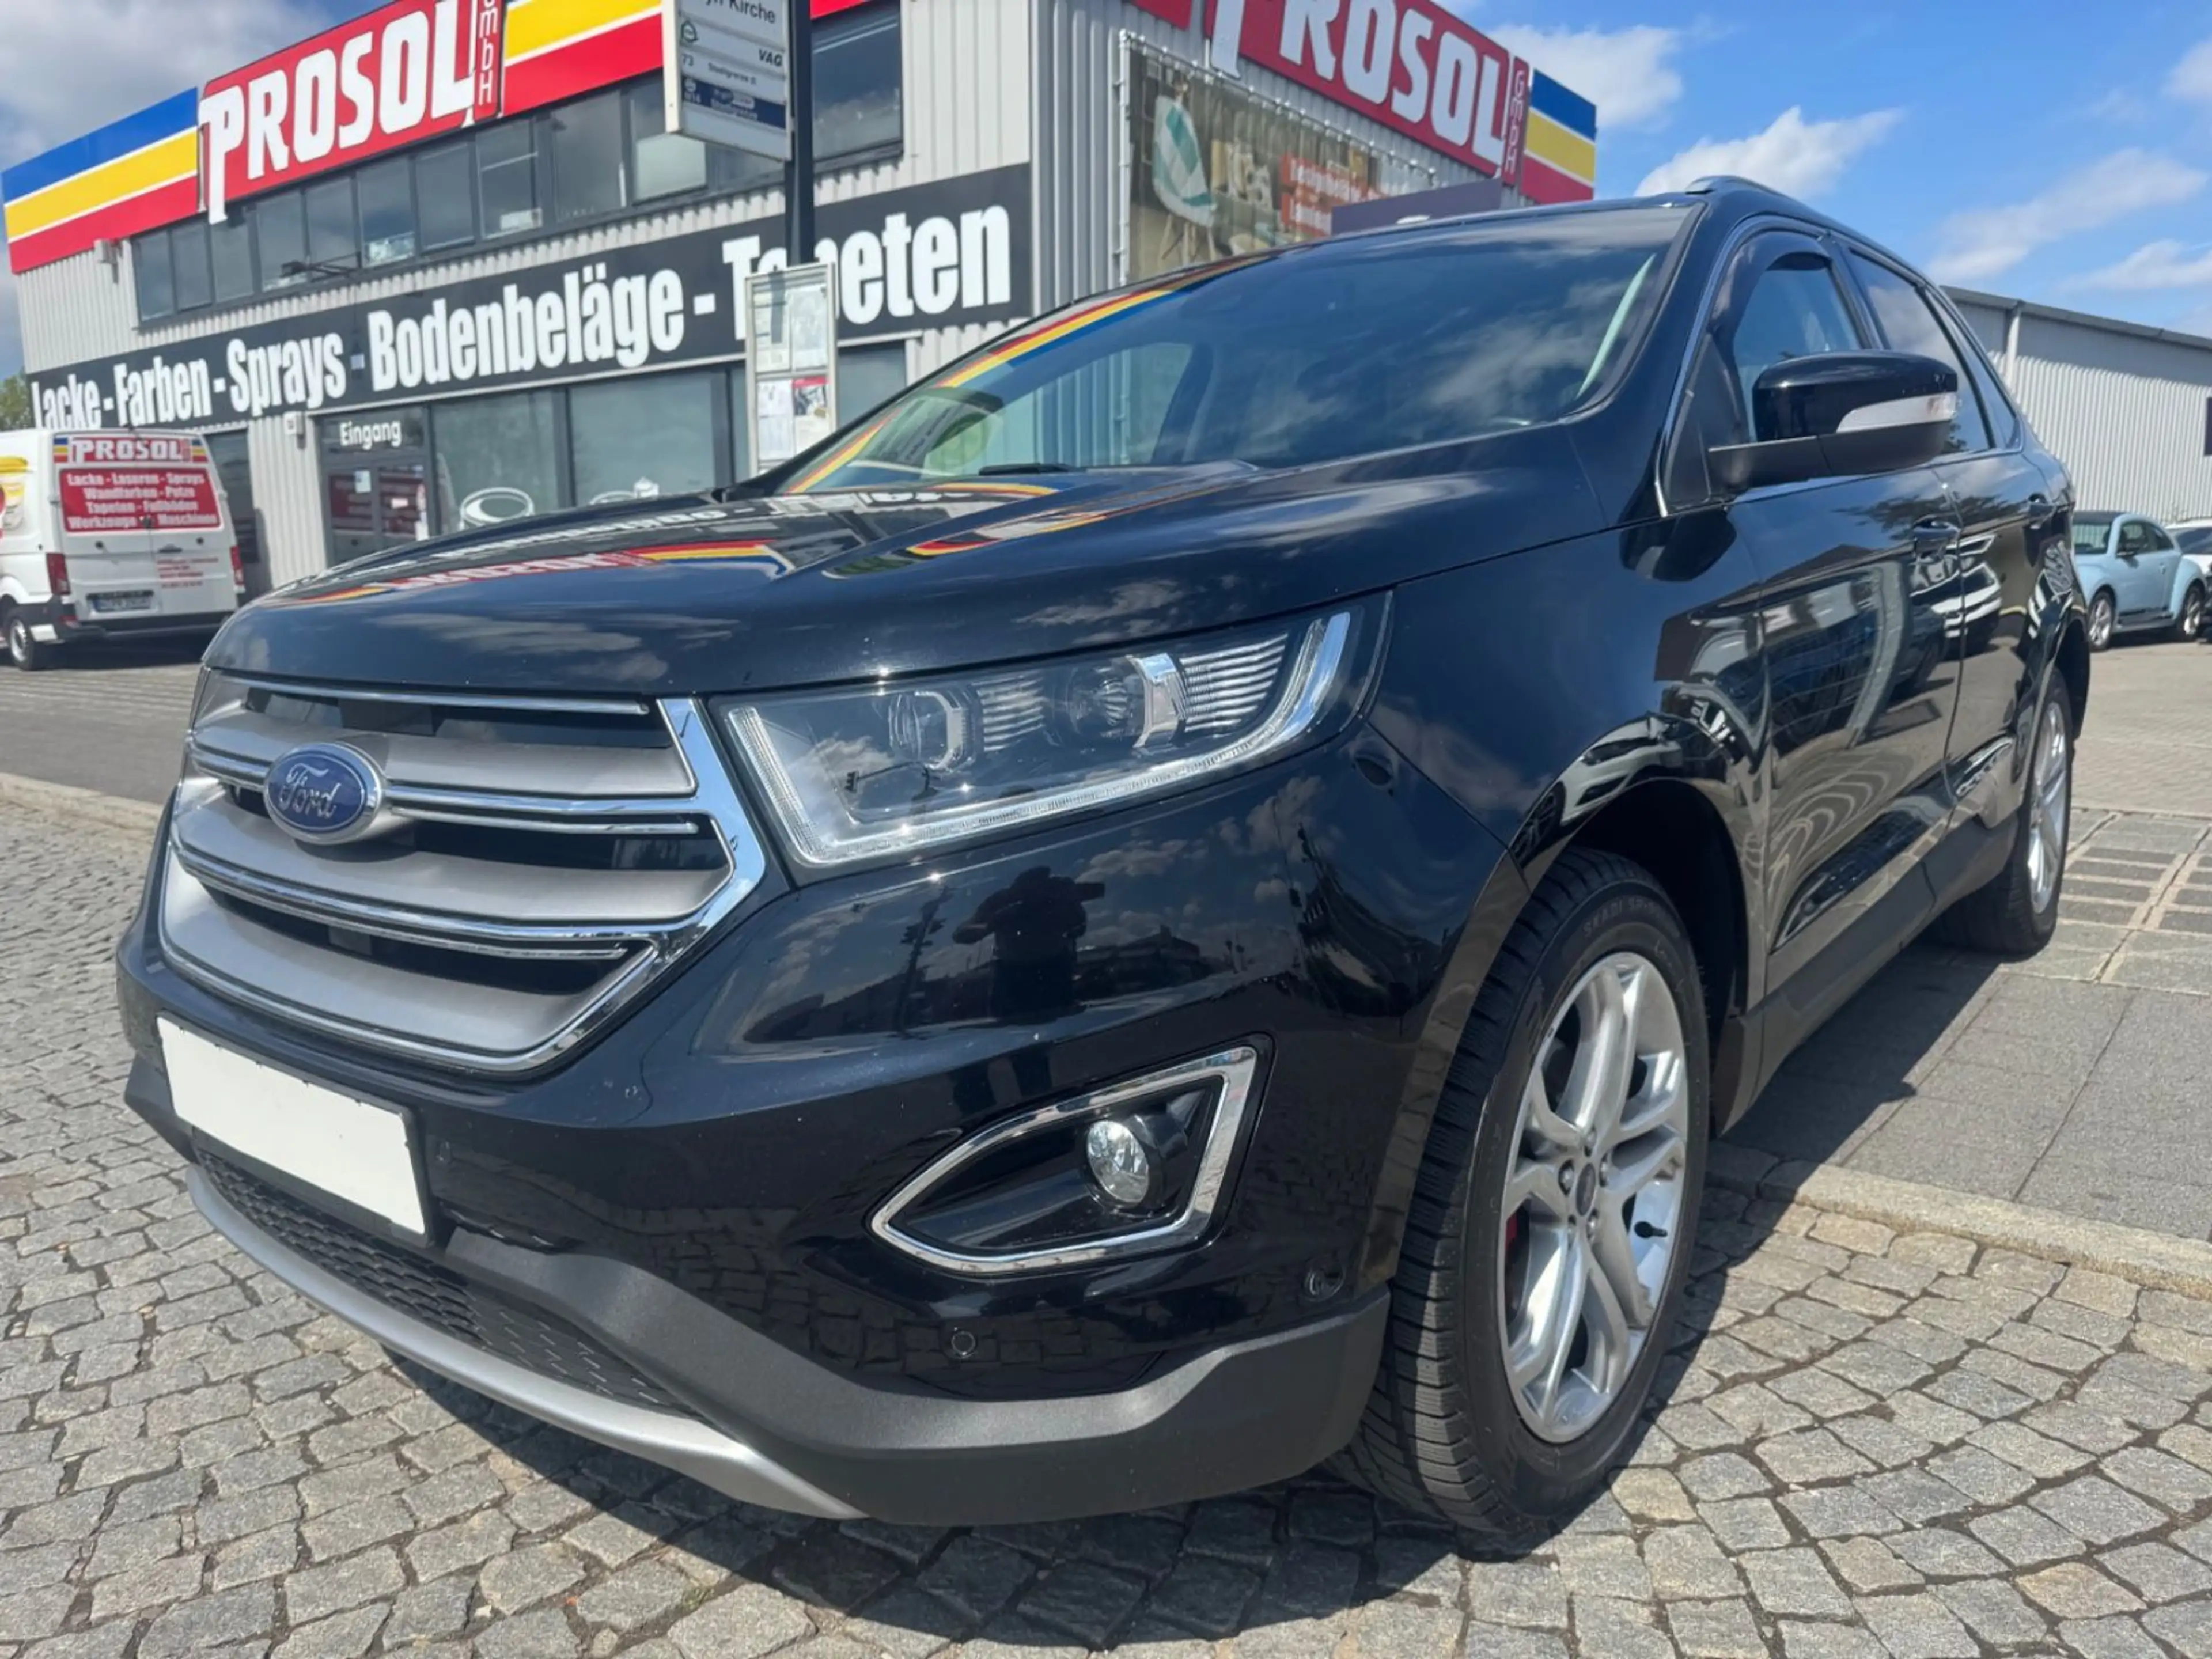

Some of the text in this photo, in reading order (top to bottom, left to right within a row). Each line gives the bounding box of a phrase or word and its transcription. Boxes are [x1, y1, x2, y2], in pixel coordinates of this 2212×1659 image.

[759, 48, 783, 67] VAG
[199, 0, 474, 225] PROSOL
[31, 374, 101, 429] Lacke
[114, 355, 213, 426] Farben
[227, 332, 346, 416] Sprays
[368, 262, 685, 391] Bodenbeläge
[722, 205, 1010, 340] Teten
[72, 440, 183, 463] PROSOL
[340, 419, 402, 450] Eingang
[279, 763, 342, 819] Ford
